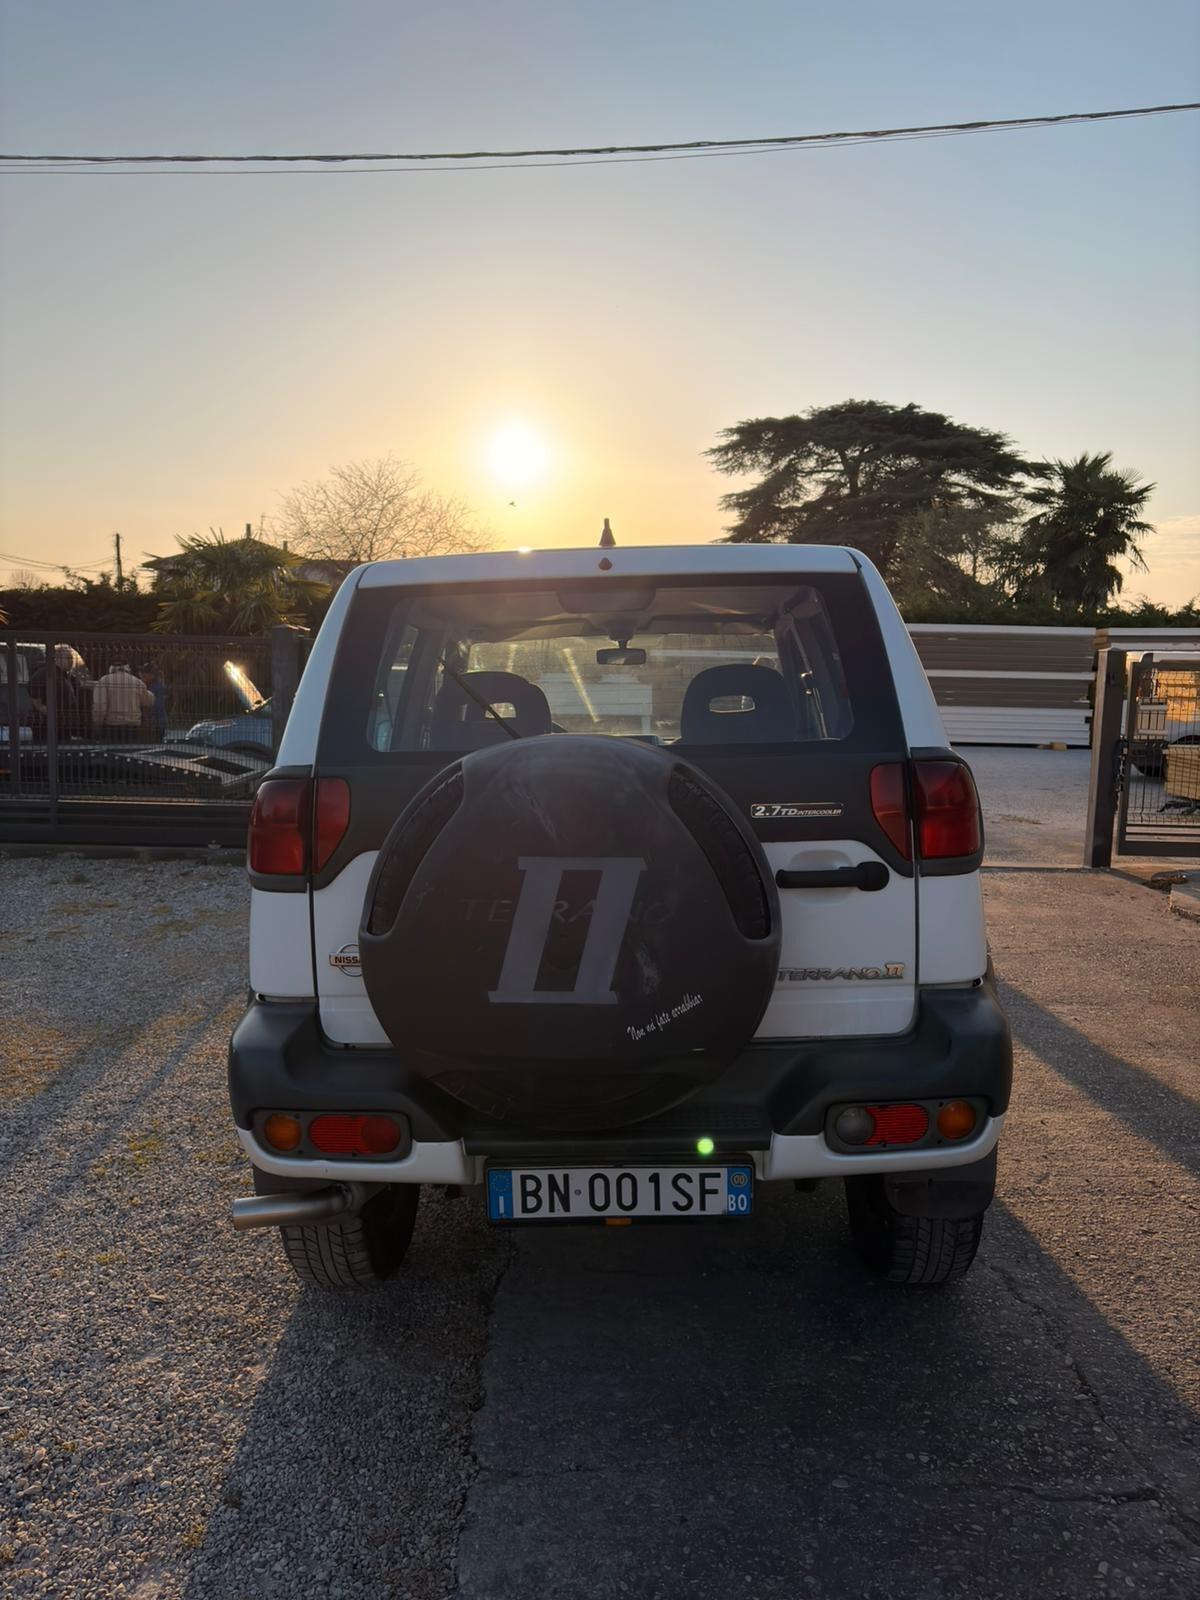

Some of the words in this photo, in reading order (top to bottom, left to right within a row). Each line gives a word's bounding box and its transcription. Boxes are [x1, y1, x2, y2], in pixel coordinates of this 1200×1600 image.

[334, 956, 361, 964] NISS
[778, 967, 881, 981] TERRANO
[626, 1026, 646, 1041] Non
[728, 1194, 748, 1211] BO
